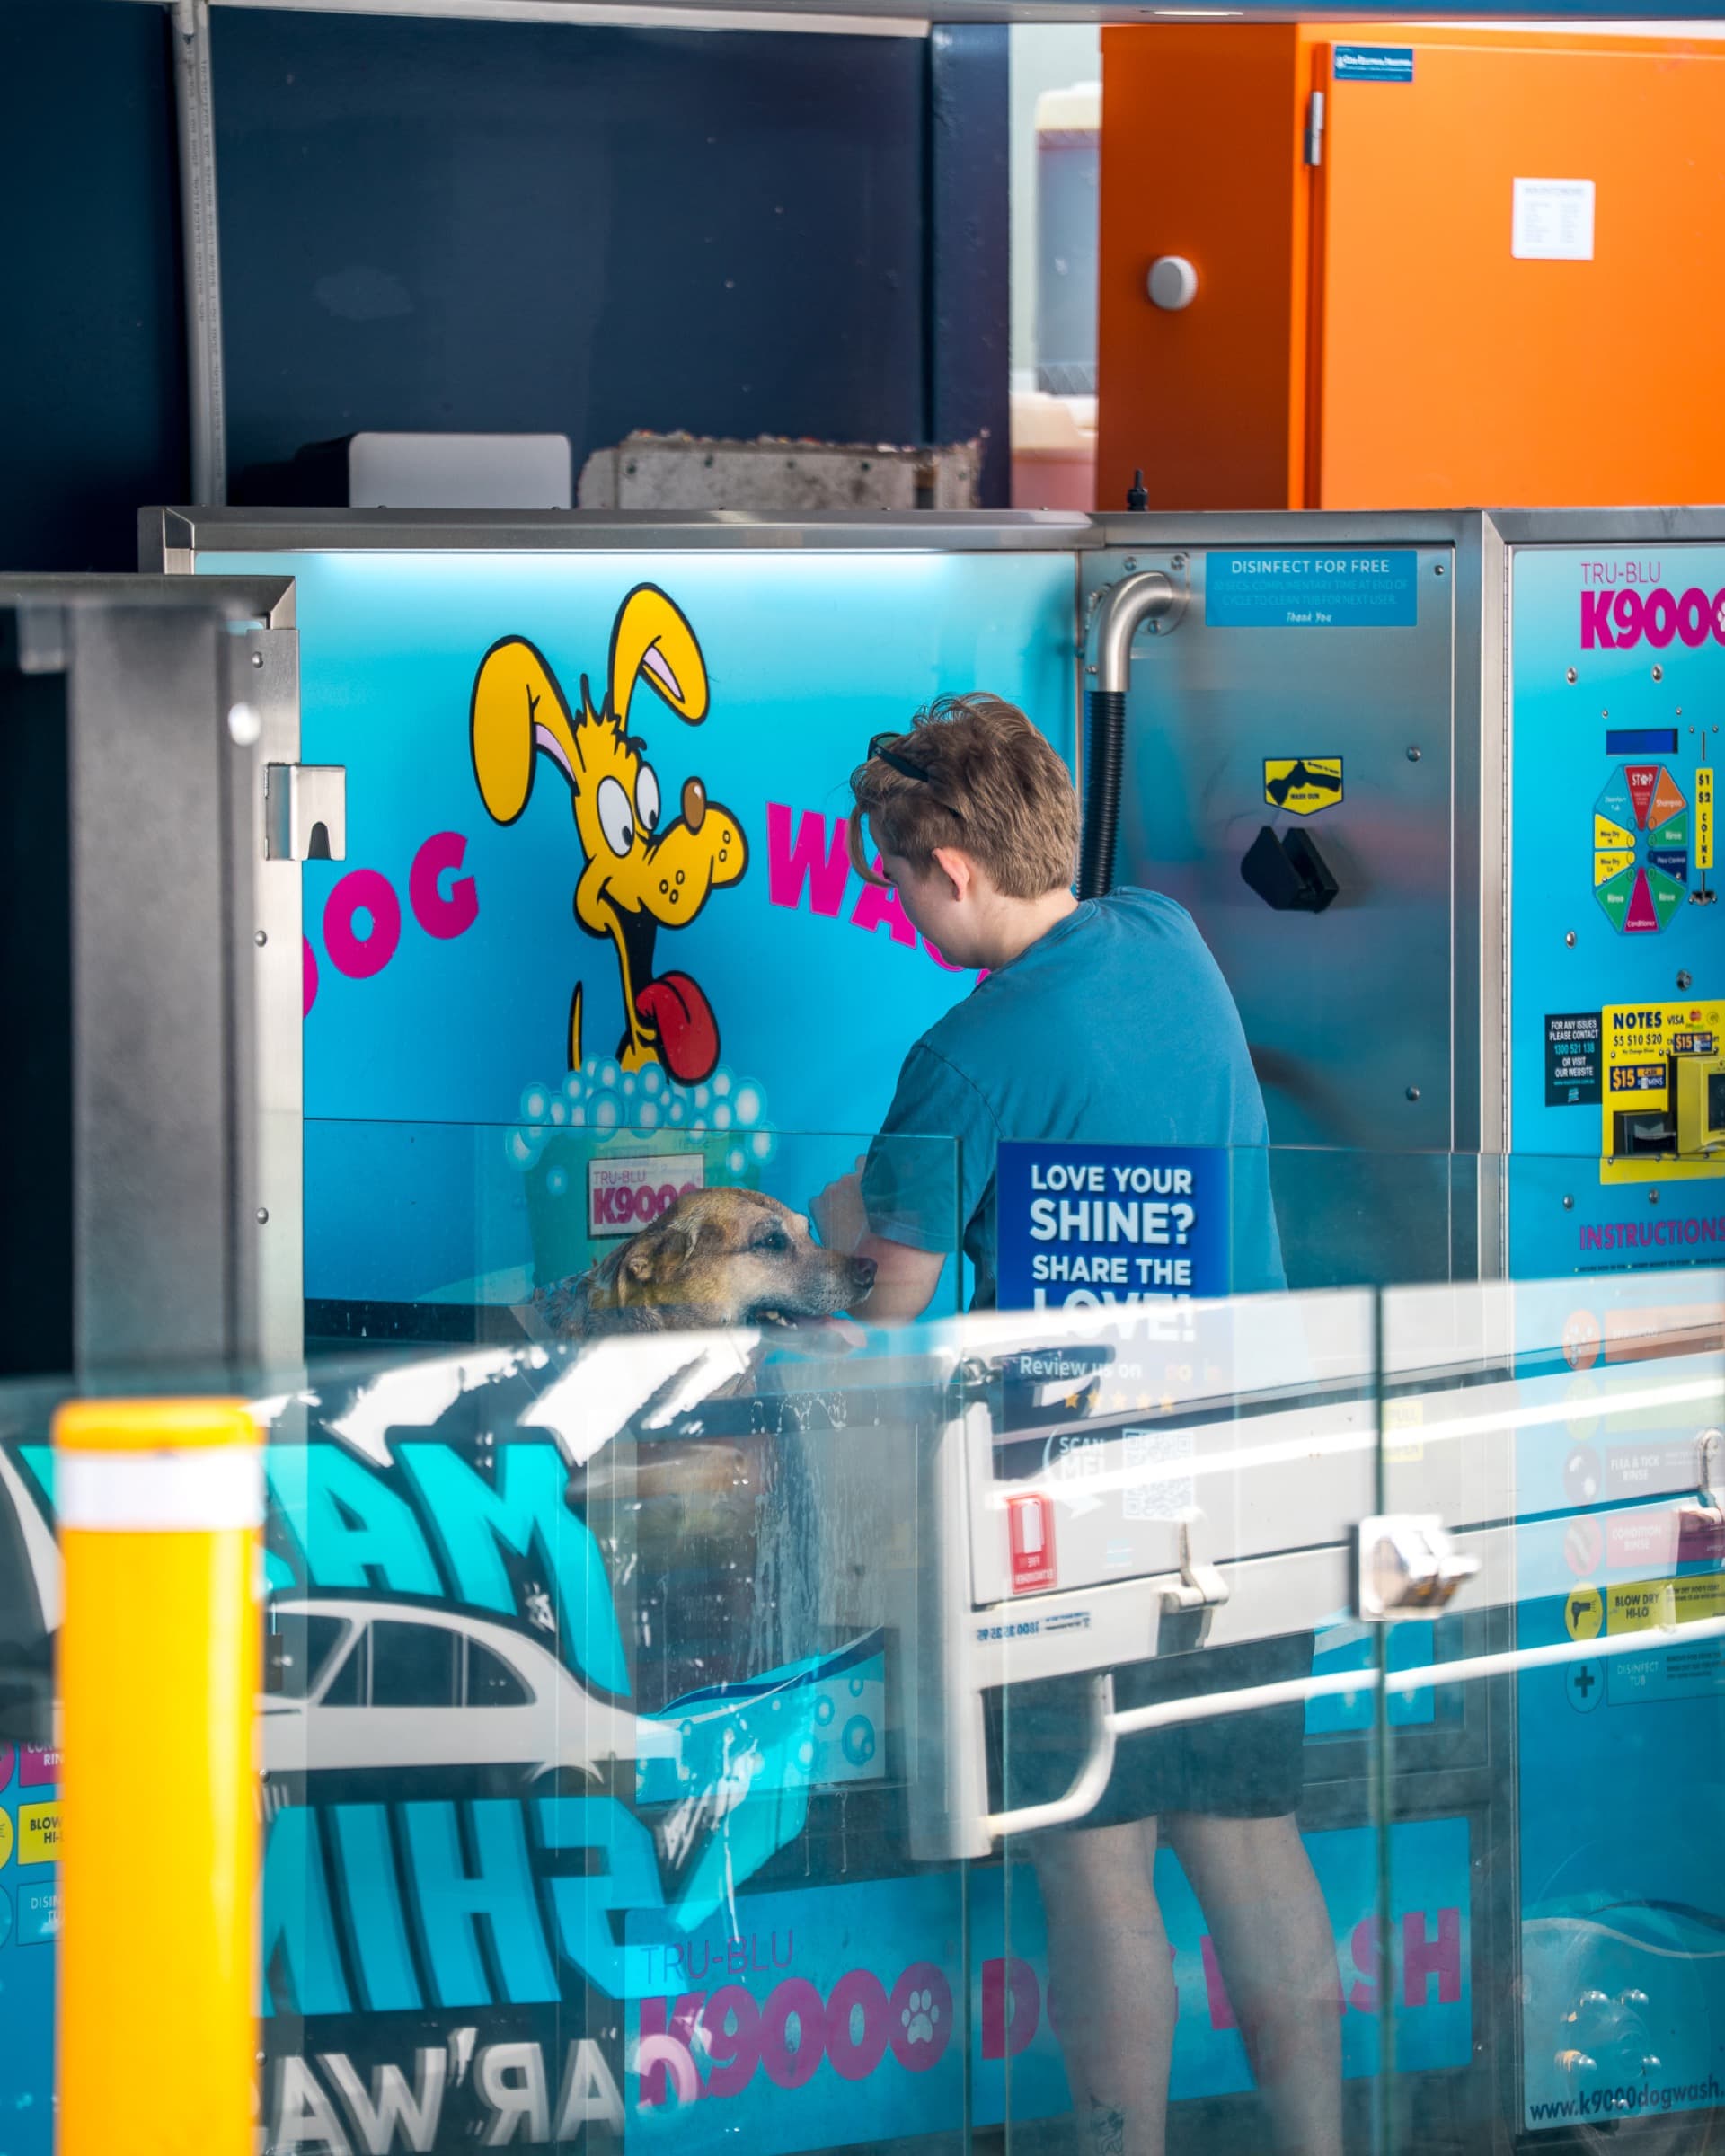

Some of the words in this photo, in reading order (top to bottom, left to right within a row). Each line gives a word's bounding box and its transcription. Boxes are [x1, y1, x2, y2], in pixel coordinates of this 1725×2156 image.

[1232, 560, 1311, 573] DISINFECT
[1315, 560, 1347, 573] FOR
[1351, 559, 1390, 573] FREE
[1580, 561, 1661, 584] TRU-BLU
[1287, 612, 1313, 623] Thank
[1315, 613, 1332, 623] You
[1698, 773, 1710, 786] $1
[1698, 791, 1711, 803] $2
[1551, 1021, 1563, 1030] FOR
[1564, 1020, 1576, 1030] ANY
[1577, 1019, 1597, 1029] ISSUES
[1614, 1012, 1662, 1030] NOTES
[1668, 1015, 1685, 1025] VISA
[1549, 1030, 1571, 1041] PLEASE
[1572, 1029, 1598, 1040] CONTACT
[1614, 1036, 1624, 1047] $5
[1627, 1034, 1643, 1046] $10
[1646, 1033, 1662, 1045] $20
[1676, 1034, 1693, 1050] $15
[1562, 1057, 1571, 1067] OR
[1572, 1056, 1587, 1066] VISIT
[1555, 1067, 1568, 1078] OUR
[1569, 1066, 1594, 1077] WEBSITE
[1613, 1067, 1635, 1090] $15
[593, 1170, 647, 1185] TRU-BLU
[1031, 1165, 1105, 1192] LOVE
[1113, 1168, 1193, 1195] YOUR
[1030, 1198, 1195, 1244] SHINE?
[1032, 1255, 1128, 1284] SHARE
[1136, 1259, 1192, 1286] THE
[1021, 1356, 1086, 1377] Review
[1092, 1363, 1114, 1378] us
[1119, 1365, 1142, 1379] on
[1059, 1436, 1104, 1454] SCAN
[1641, 1454, 1661, 1468] TICK
[1614, 1595, 1641, 1607] BLOW
[1642, 1593, 1660, 1606] DRY
[1626, 1606, 1650, 1620] HI-LO
[1617, 1661, 1659, 1675] DISINFECT
[1630, 1674, 1646, 1687] TUB
[641, 1929, 793, 1984] TRU-BLU
